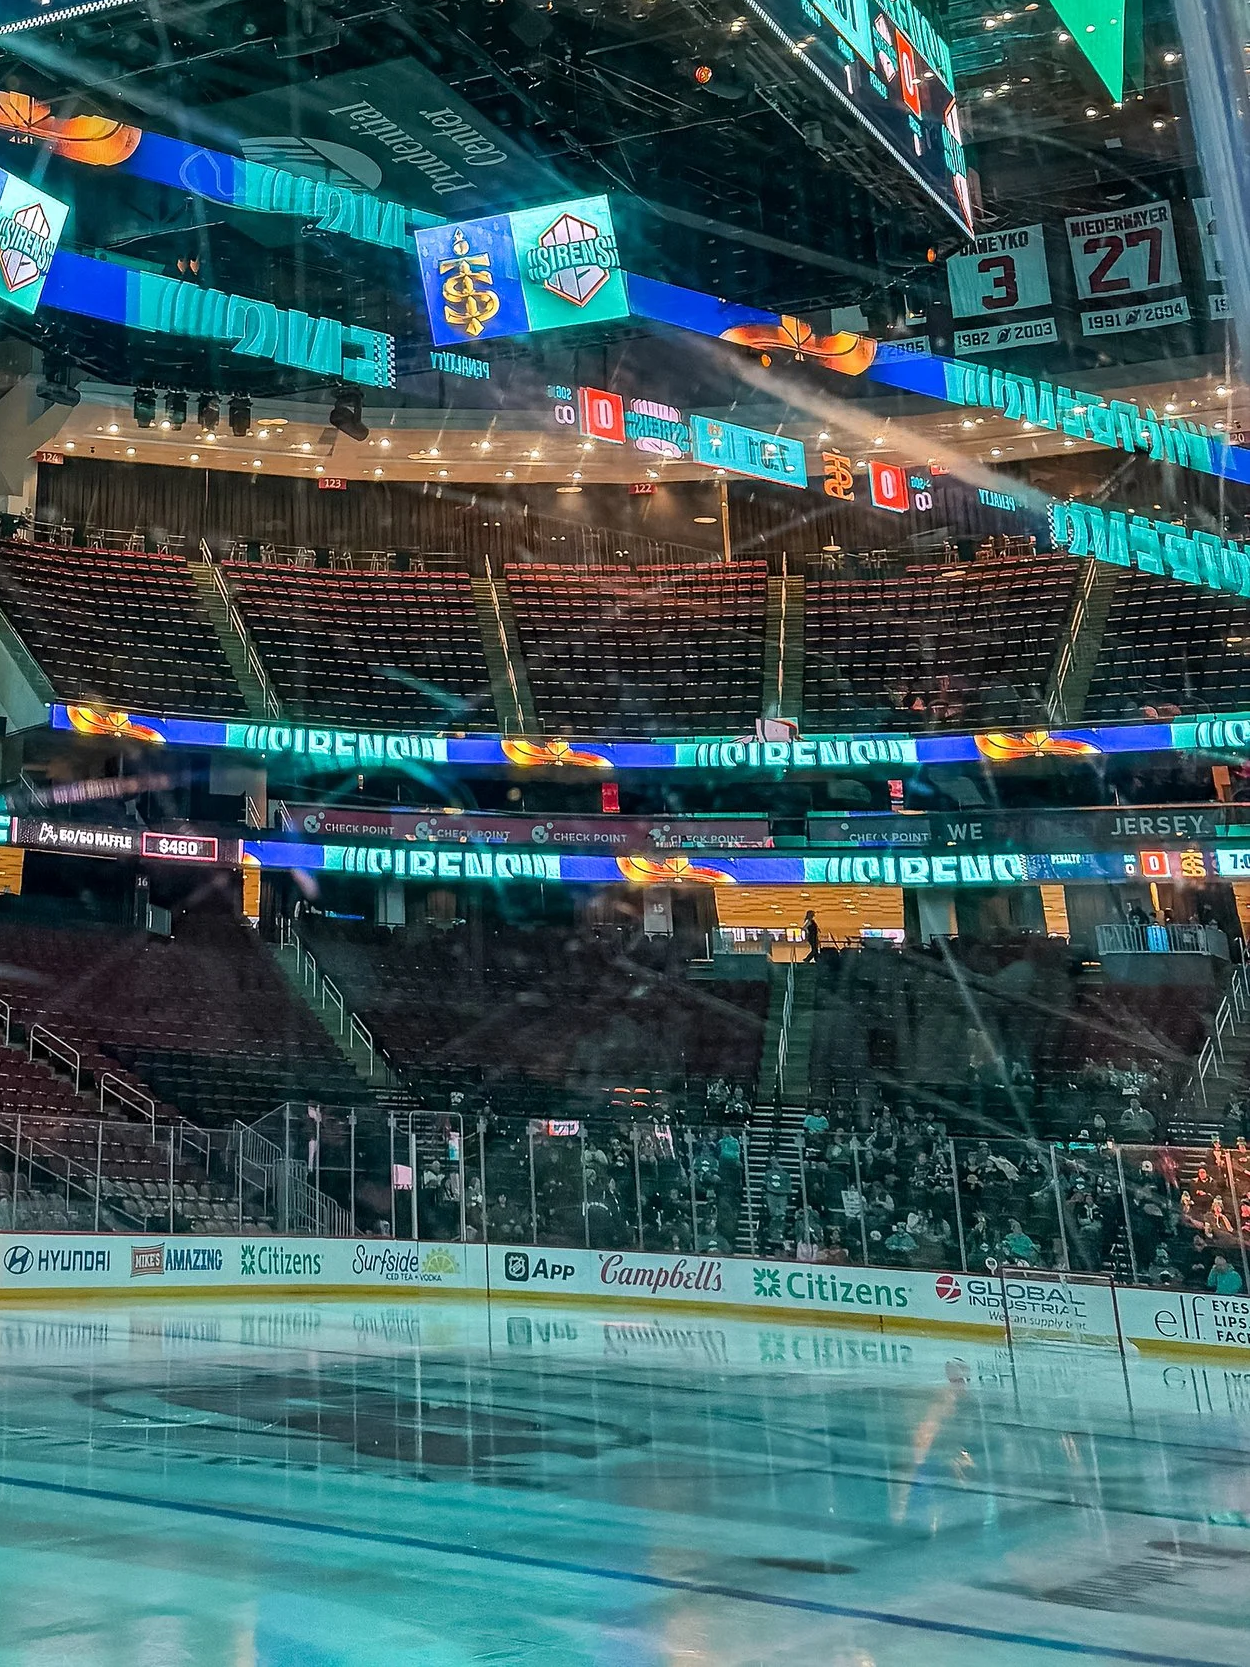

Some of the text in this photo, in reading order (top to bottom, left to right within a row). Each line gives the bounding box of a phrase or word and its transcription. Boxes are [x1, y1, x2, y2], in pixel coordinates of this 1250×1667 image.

[327, 100, 478, 195] Prudential
[419, 106, 509, 167] Center
[1069, 207, 1169, 239] NIEDERMAYER
[960, 230, 1030, 258] DANEYKO
[537, 244, 613, 283] SIRENS
[1082, 226, 1163, 295] 27
[977, 254, 1020, 311] 3
[1087, 305, 1184, 330] 1991 2004
[956, 322, 1054, 348] 1982 2003
[634, 484, 652, 495] 122
[325, 823, 395, 835] CHECK POINT
[437, 828, 511, 840] CHECK POINT
[553, 832, 628, 844] CHECK POINT
[849, 832, 929, 843] CHECK POINT
[947, 823, 984, 841] WE
[94, 834, 133, 850] RAFFLE
[1149, 856, 1159, 871] 0
[137, 876, 149, 887] 16
[652, 902, 664, 914] 15
[37, 1249, 111, 1272] HYUNDAI
[135, 1249, 223, 1272] MIKE'S AMAZING
[258, 1247, 322, 1277] Citizens
[352, 1243, 420, 1276] Surfside
[385, 1272, 443, 1283] ICED TEA VODKA
[598, 1253, 727, 1294] Campbell's
[785, 1271, 910, 1309] Citizens
[967, 1280, 1086, 1306] GLOBAL
[969, 1295, 1087, 1318] INDUSTRIAL
[989, 1310, 1064, 1329] We can supply
